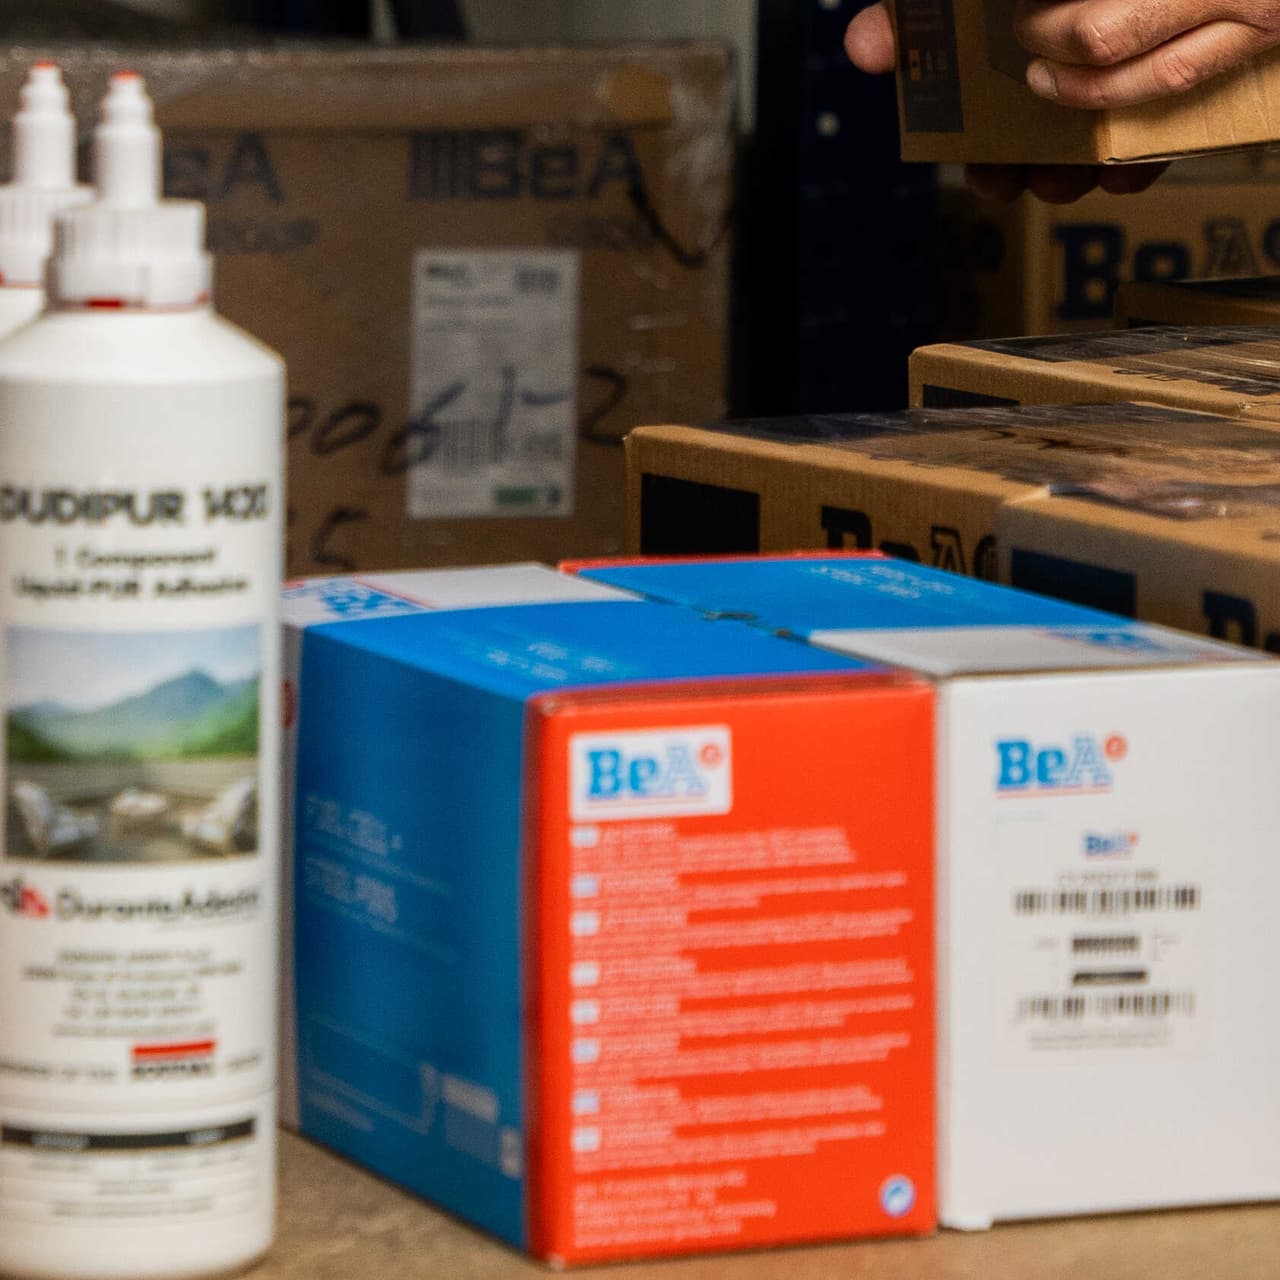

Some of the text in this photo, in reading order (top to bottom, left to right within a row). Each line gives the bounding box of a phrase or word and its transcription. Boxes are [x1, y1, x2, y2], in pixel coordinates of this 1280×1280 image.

[470, 128, 640, 201] BeA
[1052, 217, 1260, 320] BeA
[586, 742, 710, 800] BeA
[995, 736, 1113, 791] BeA
